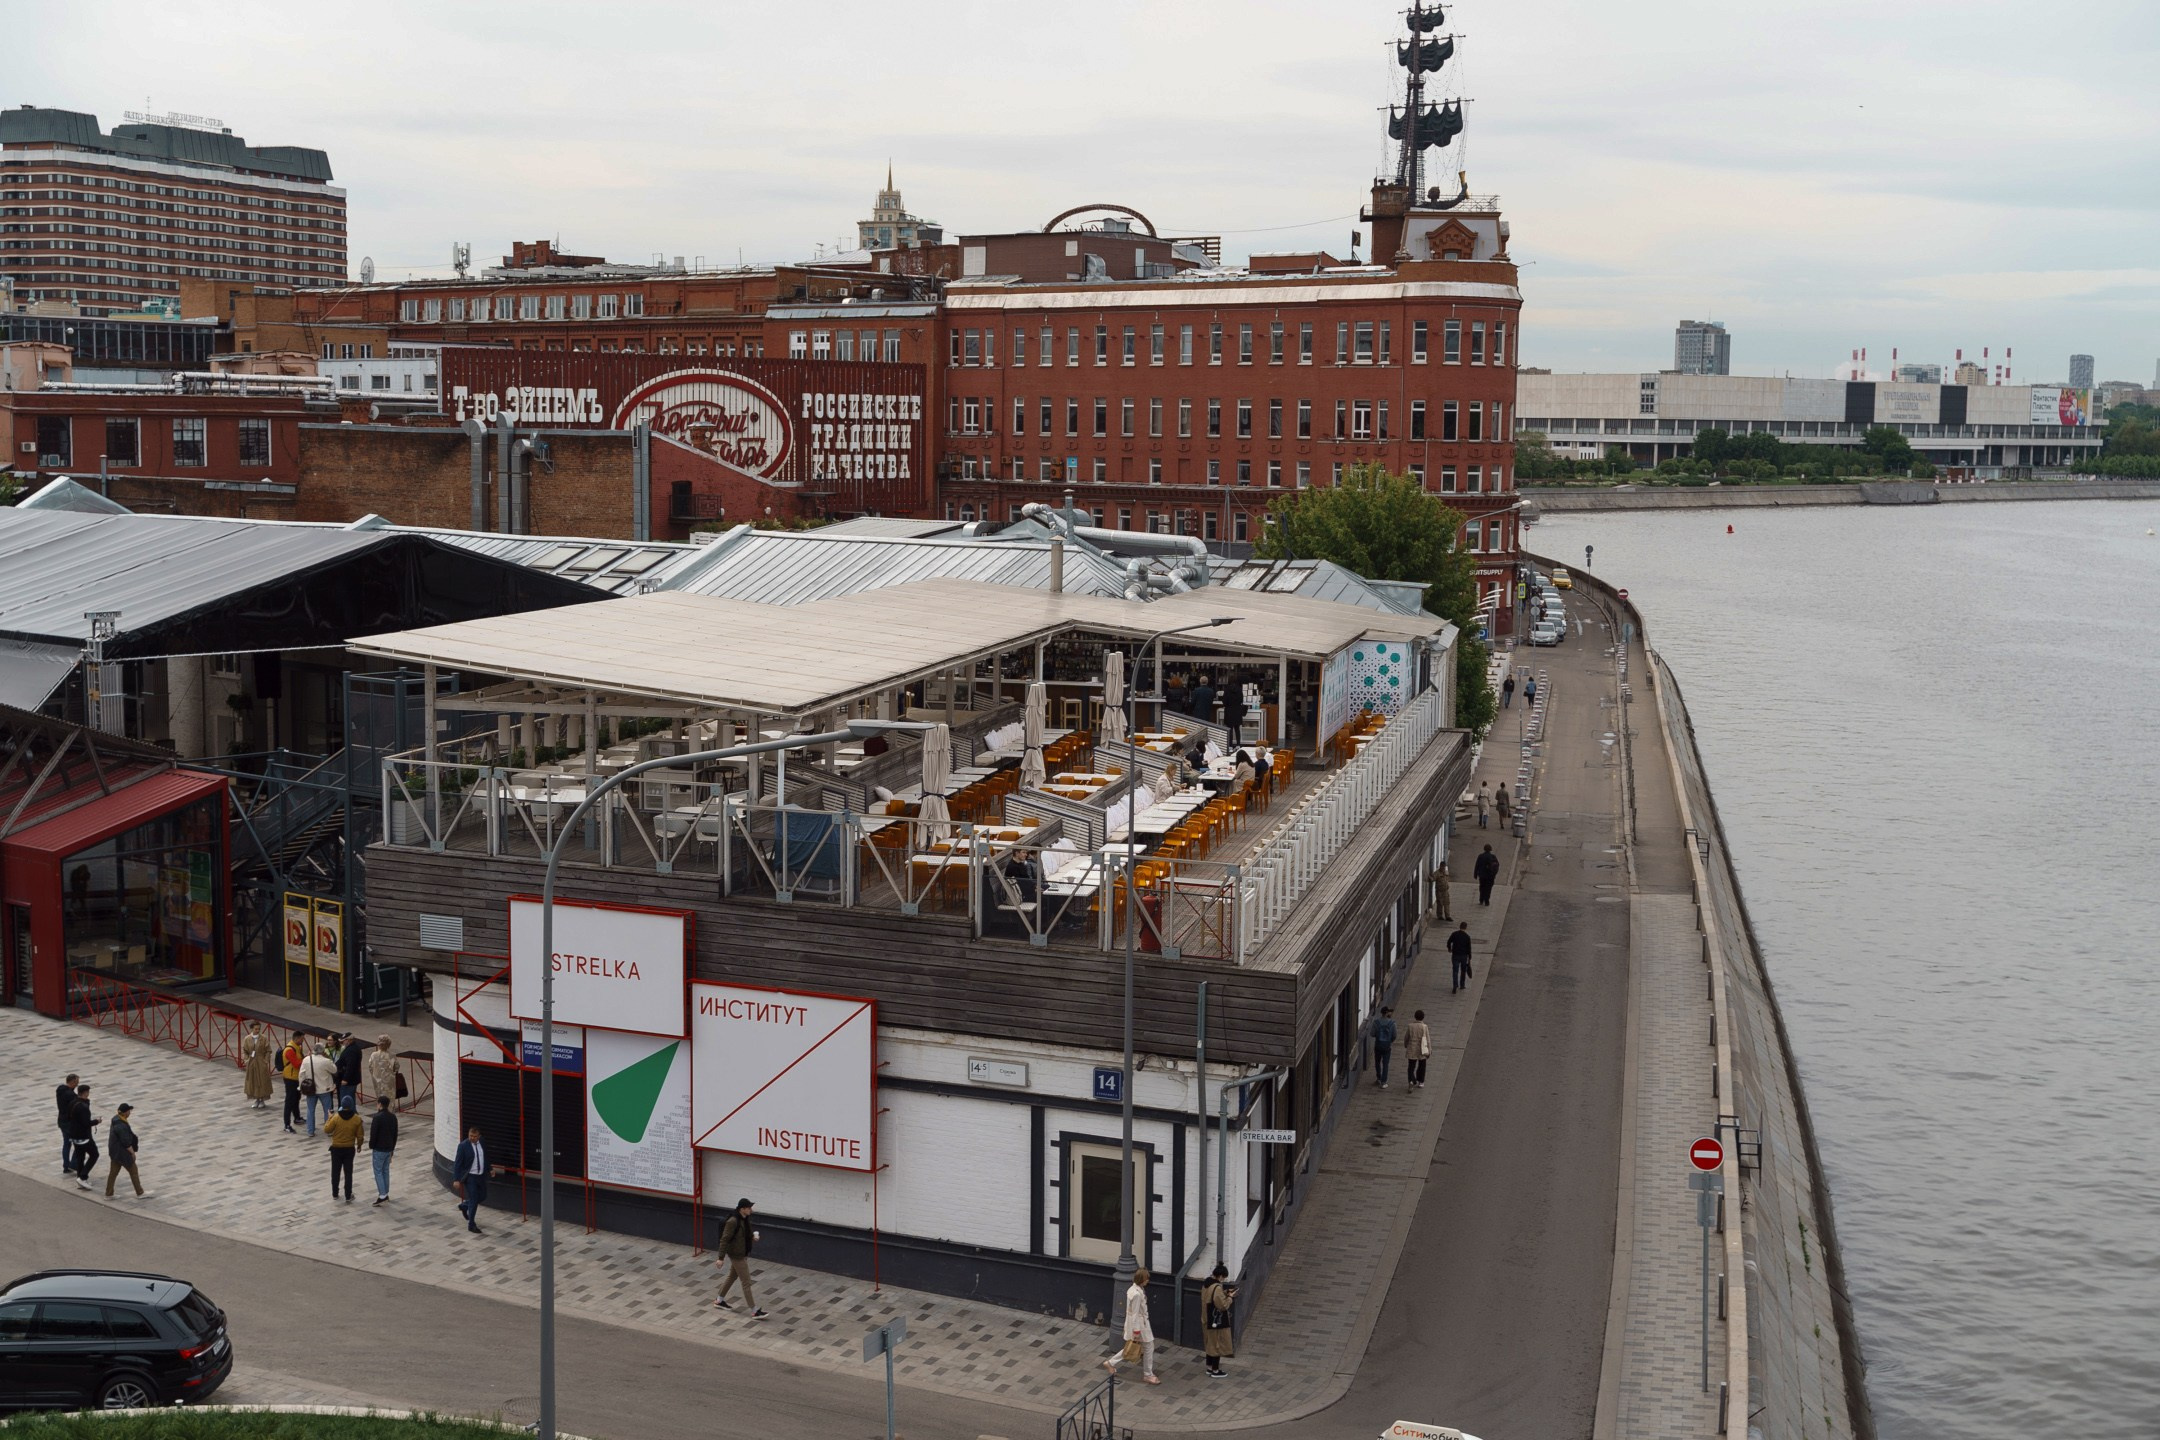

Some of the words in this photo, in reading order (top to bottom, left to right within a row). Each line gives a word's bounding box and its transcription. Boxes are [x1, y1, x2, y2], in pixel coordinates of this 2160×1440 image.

[505, 386, 603, 423] ЭЙНЕМЪ
[802, 393, 920, 420] РОССИЙСКИЕ
[811, 423, 911, 452] ТРАДИЦИИ
[812, 454, 910, 479] КАЧЕСТВА
[551, 953, 641, 981] STRELKA
[700, 996, 808, 1027] ИНСТИТУТ
[1098, 1074, 1116, 1091] 14
[758, 1127, 861, 1160] INSTITUTE
[1242, 1132, 1275, 1141] STRELKA
[1277, 1134, 1293, 1142] BAR
